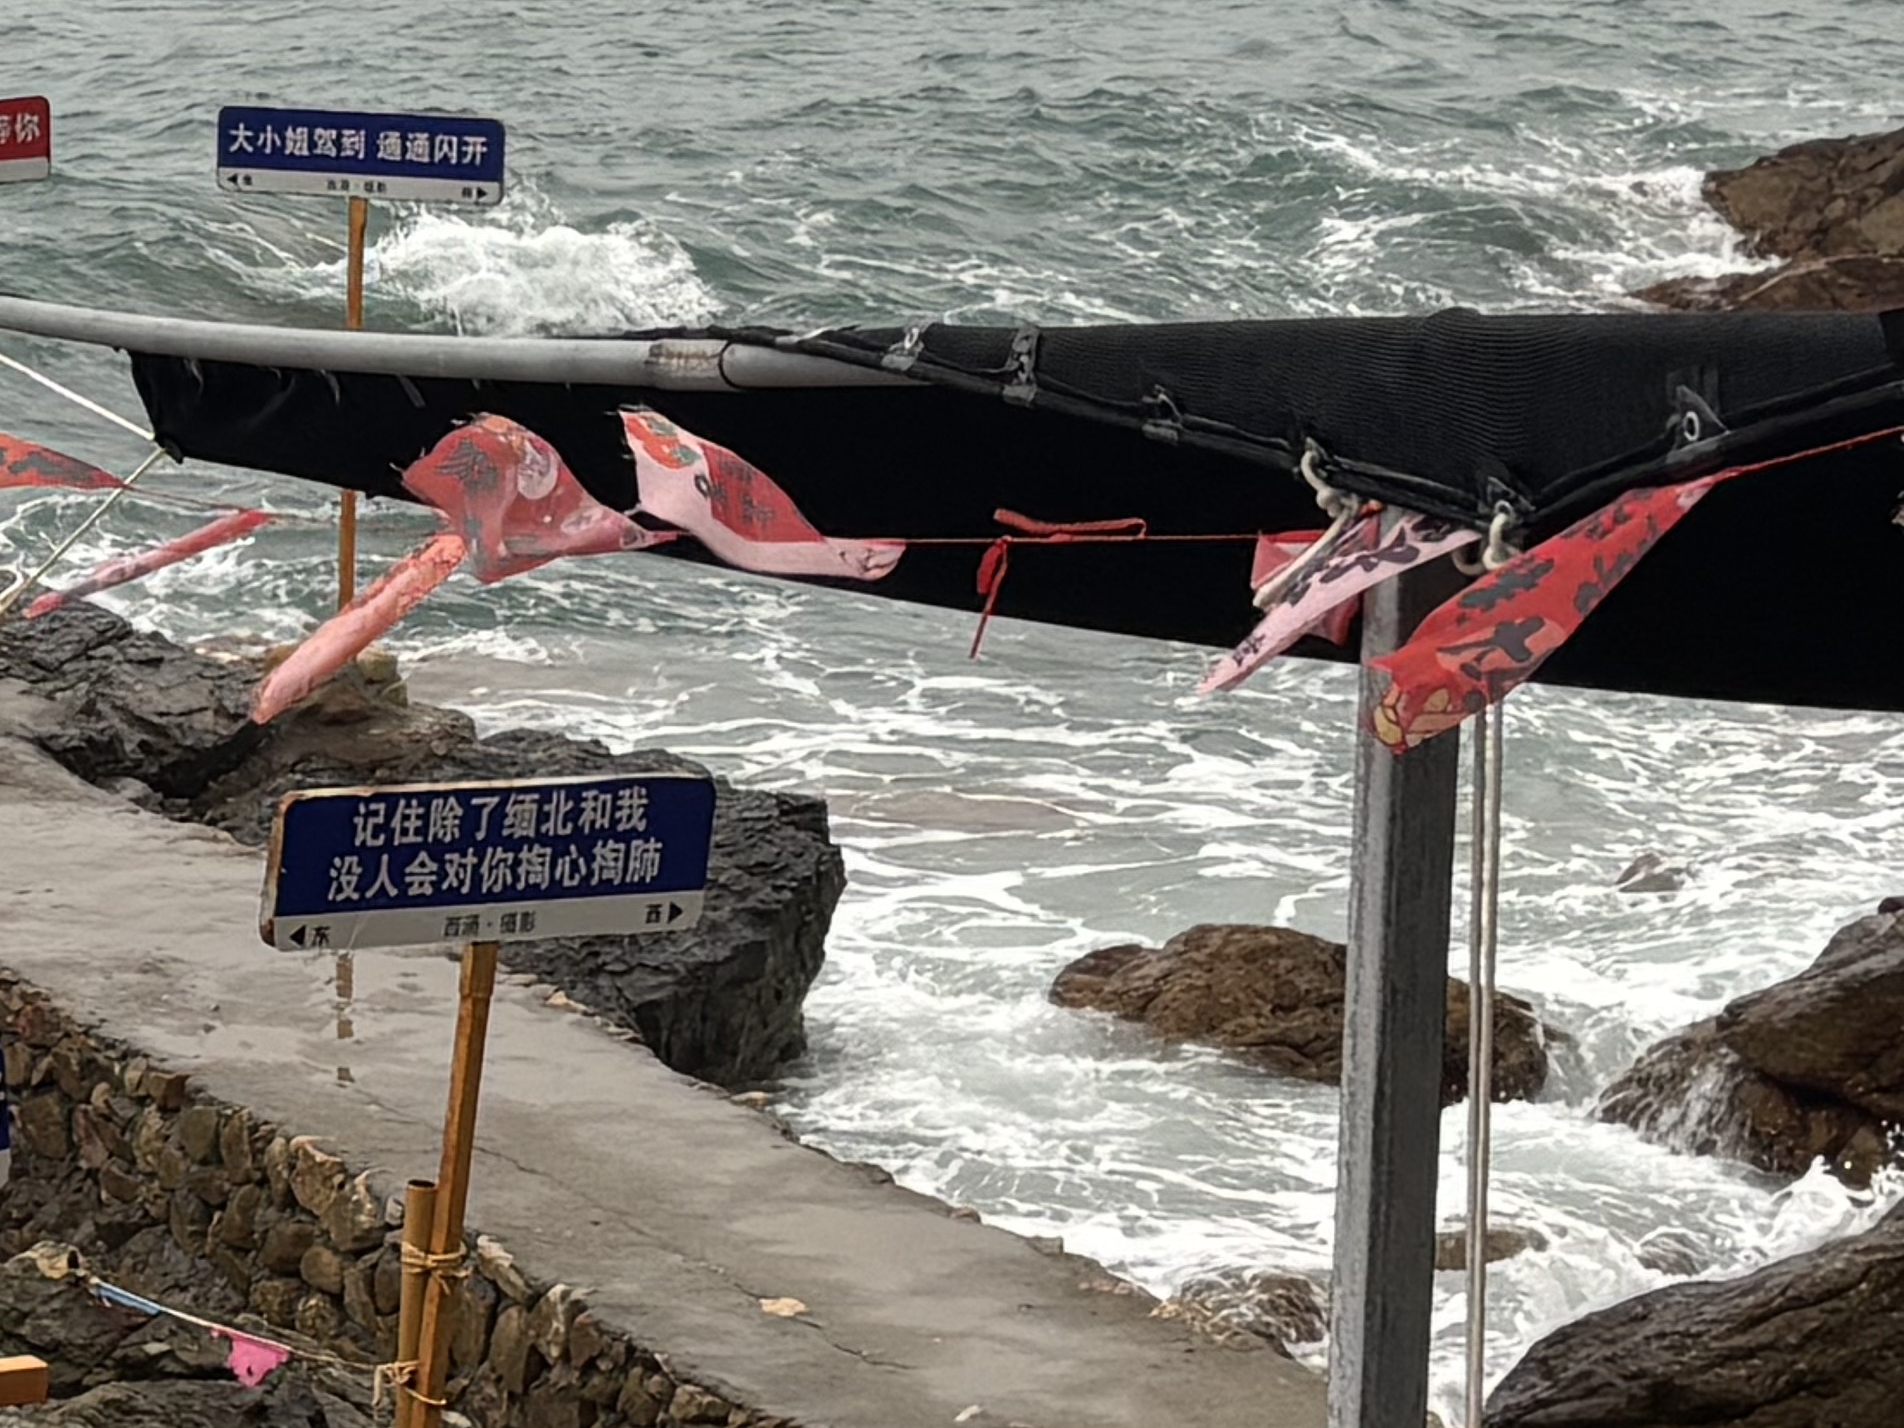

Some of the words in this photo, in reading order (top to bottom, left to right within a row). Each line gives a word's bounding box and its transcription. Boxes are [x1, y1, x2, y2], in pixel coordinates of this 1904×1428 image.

[228, 123, 366, 159] 大小姐驾到
[376, 131, 488, 165] 通通闪开
[352, 785, 649, 847] 记住除了缅北和我
[327, 836, 663, 902] 没人会对你掏心掏肺
